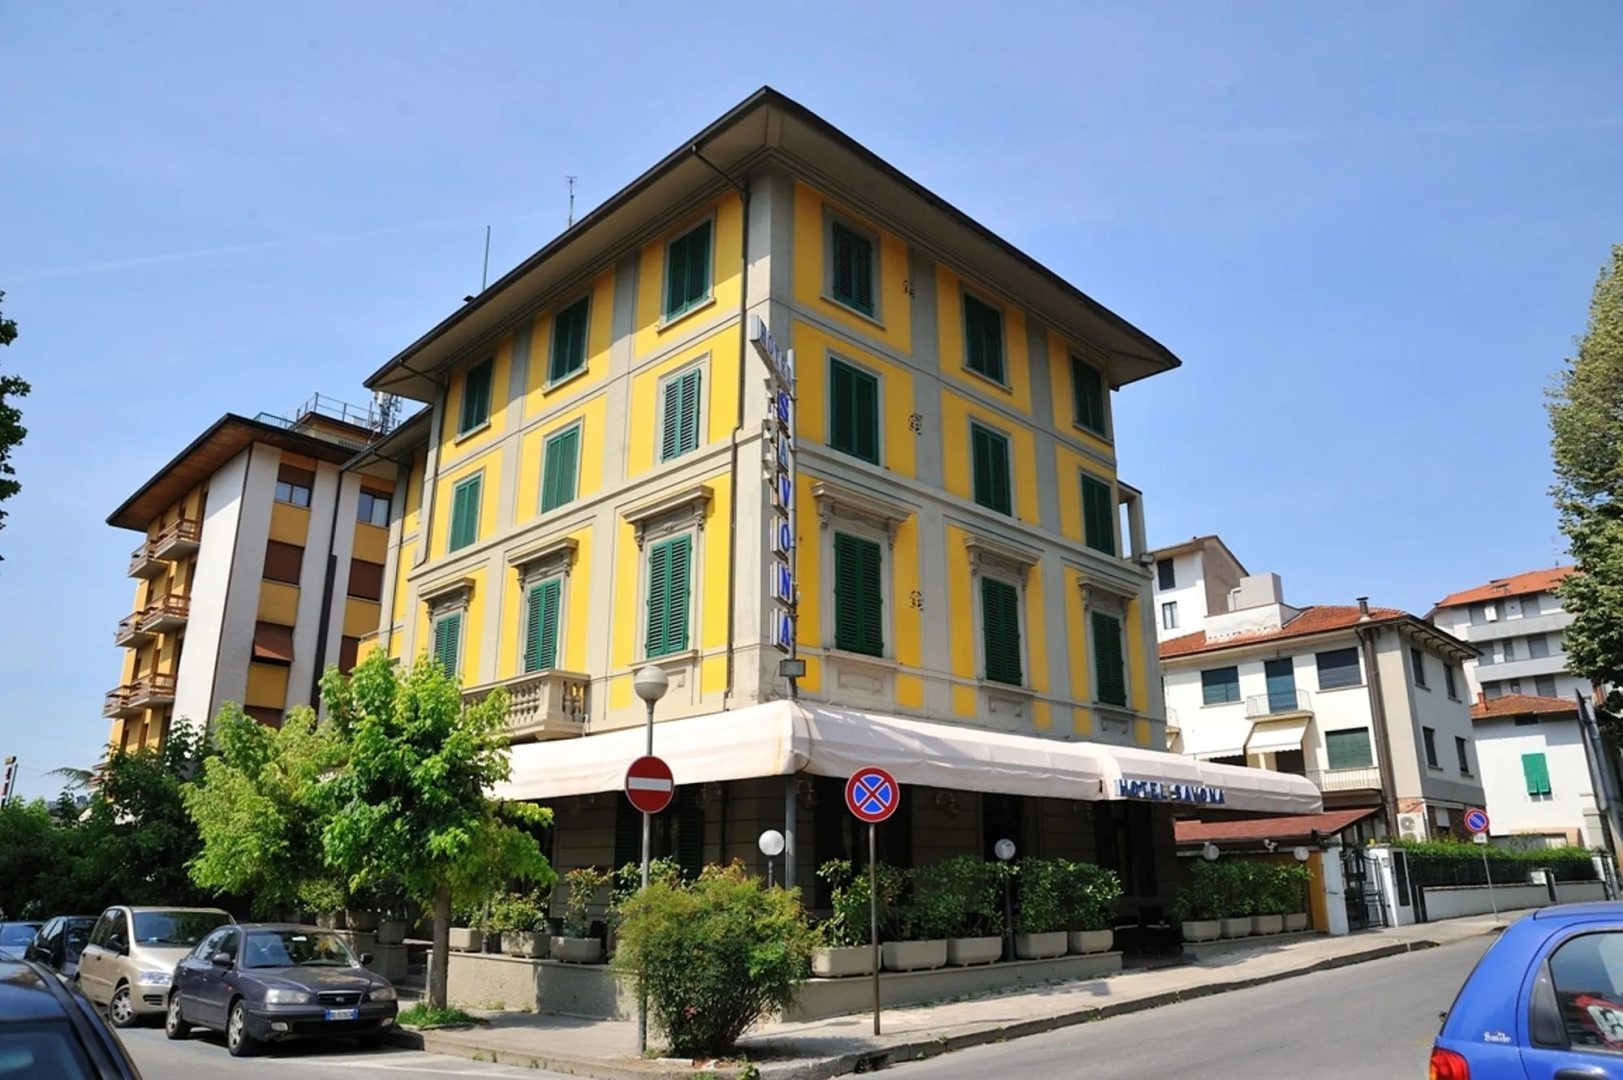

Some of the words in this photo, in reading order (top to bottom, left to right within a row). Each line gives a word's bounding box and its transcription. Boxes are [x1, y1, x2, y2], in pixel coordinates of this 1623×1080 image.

[760, 318, 792, 387] HOTEL
[777, 390, 792, 647] SAVONA
[1119, 779, 1168, 799] HOTEL
[1175, 784, 1225, 804] SAVONA
[1483, 1030, 1512, 1043] Smile
